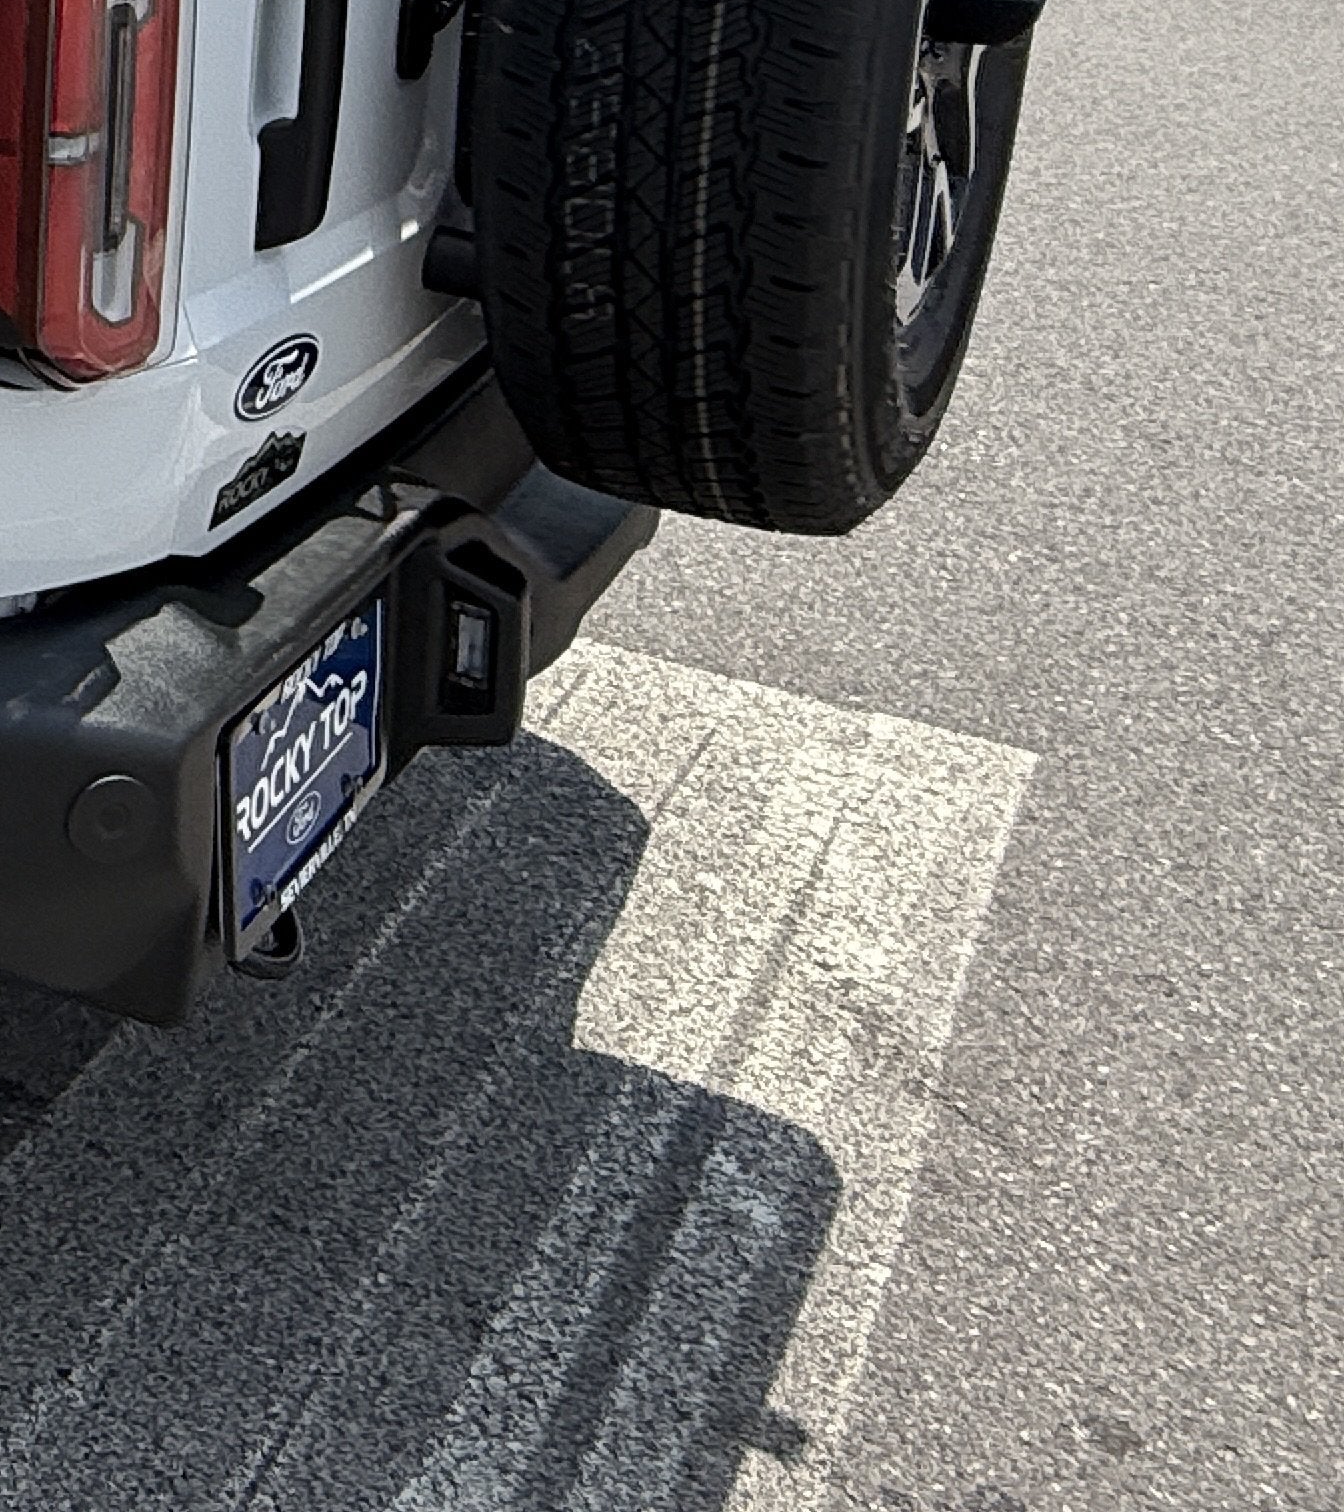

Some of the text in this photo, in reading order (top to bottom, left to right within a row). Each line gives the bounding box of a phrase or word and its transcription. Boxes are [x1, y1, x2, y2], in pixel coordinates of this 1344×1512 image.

[255, 349, 310, 409] Ford
[236, 670, 367, 840] ROCKY TOP
